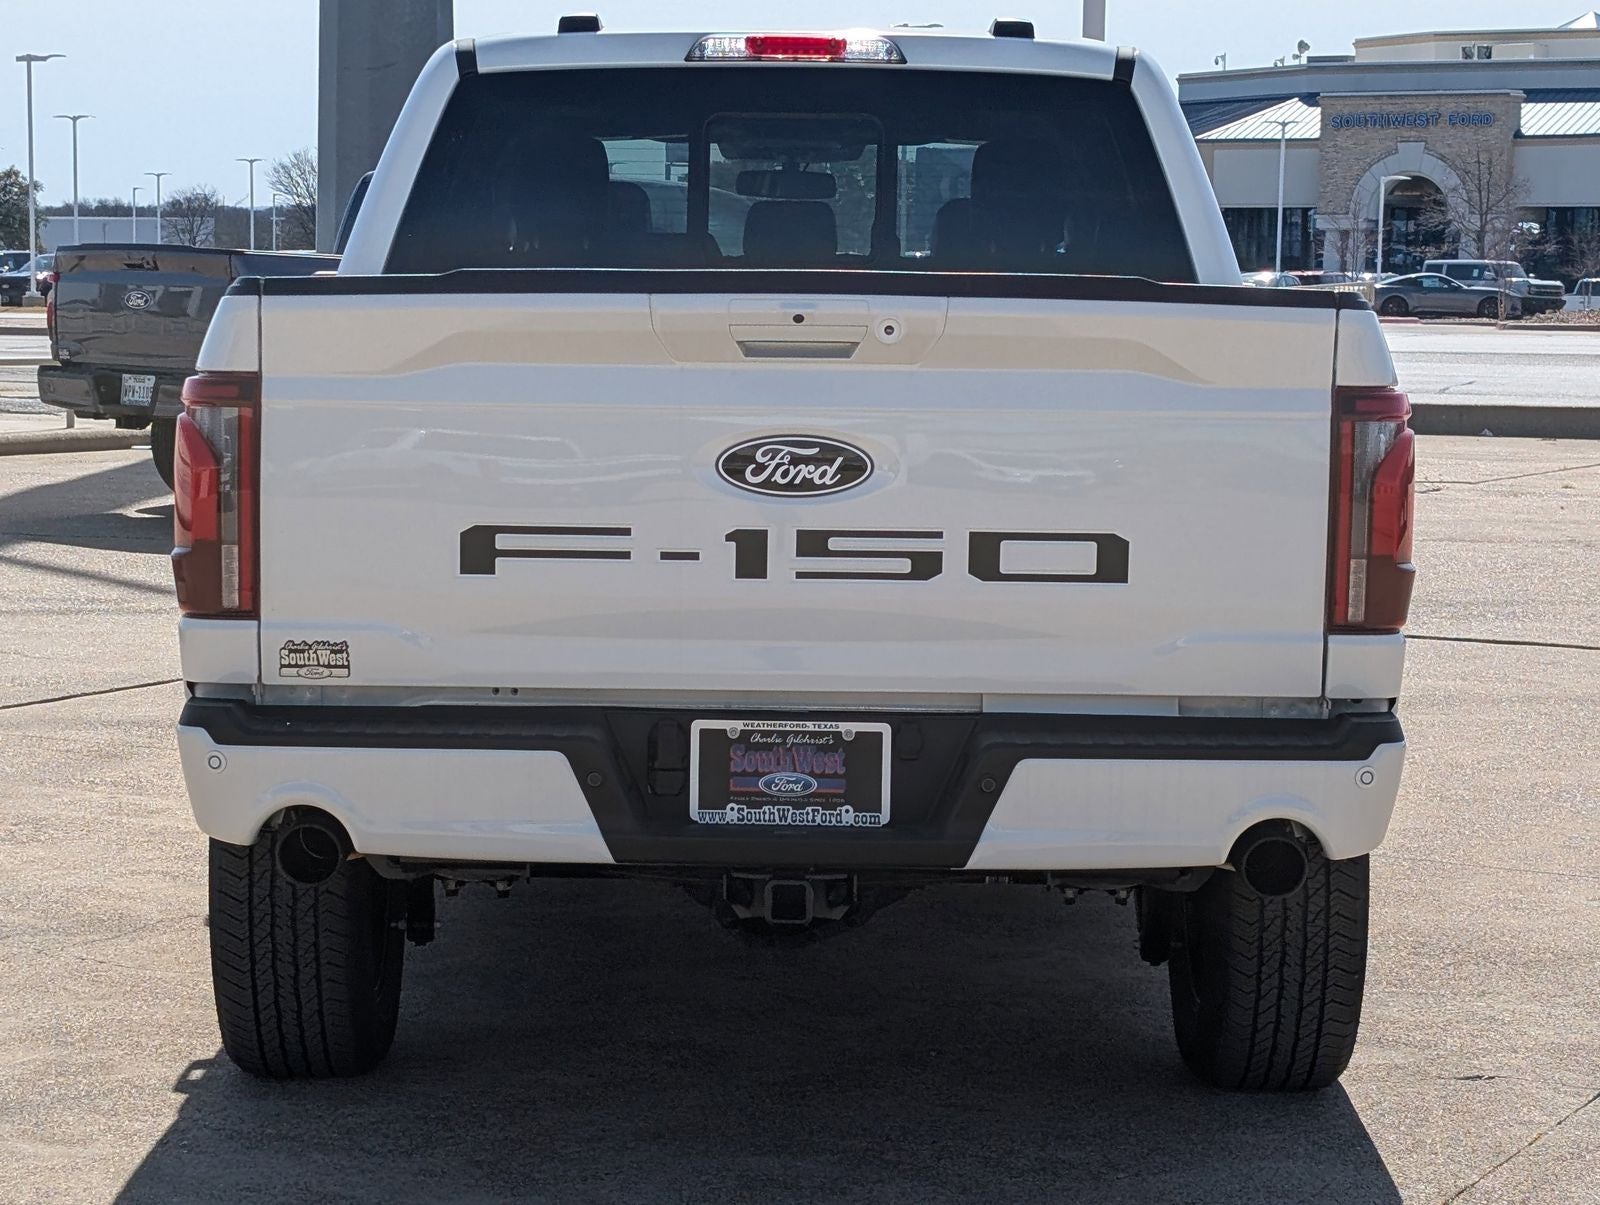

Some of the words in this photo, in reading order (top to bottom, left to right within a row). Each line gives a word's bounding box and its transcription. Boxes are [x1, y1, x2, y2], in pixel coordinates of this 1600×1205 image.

[1330, 111, 1441, 129] SOUTHWEST
[1447, 111, 1494, 127] FORD
[128, 293, 147, 306] Ford
[744, 444, 844, 485] Ford
[459, 524, 1130, 584] F-150
[280, 649, 348, 666] SouthWest
[303, 667, 325, 676] Ford
[812, 722, 840, 730] TEXAS
[750, 731, 783, 743] Charlie
[785, 732, 835, 748] Gilchrist's
[729, 743, 847, 774] SouthWest
[771, 775, 804, 792] Ford
